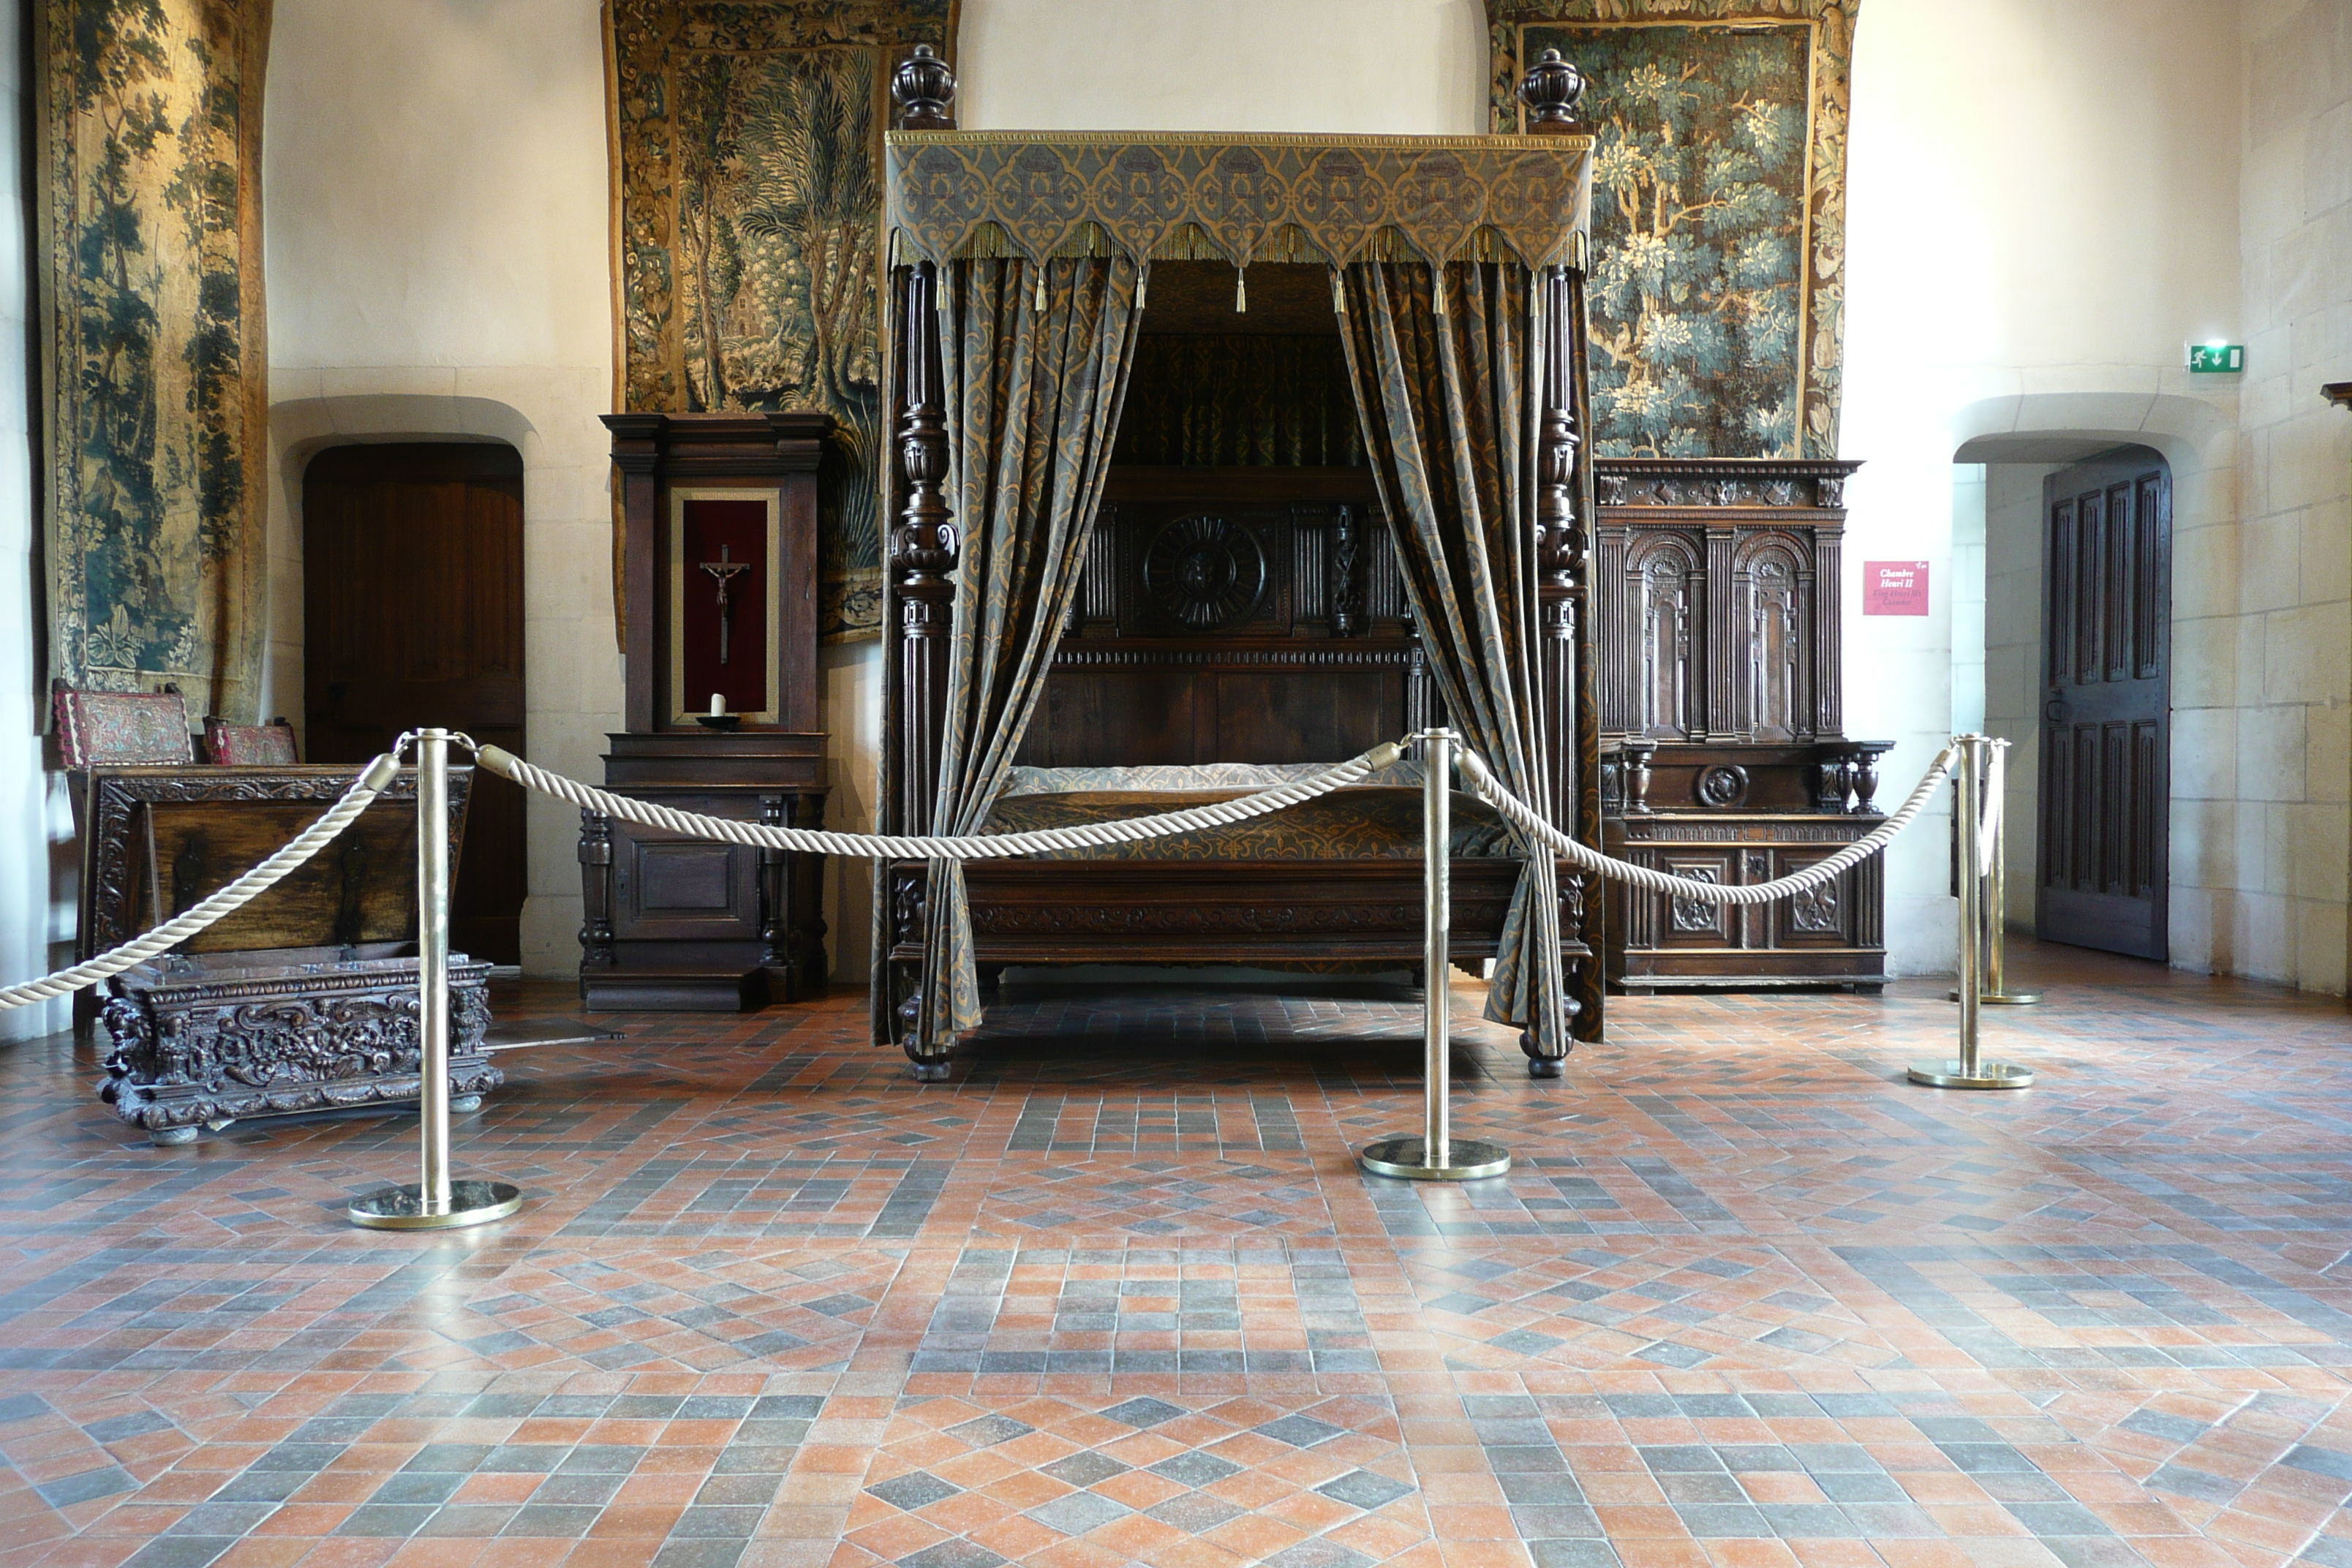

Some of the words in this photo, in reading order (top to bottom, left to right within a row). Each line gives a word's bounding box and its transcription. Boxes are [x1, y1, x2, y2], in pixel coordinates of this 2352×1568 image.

[1880, 568, 1914, 578] Chambre
[1880, 578, 1904, 588] Henri
[1904, 578, 1914, 588] II
